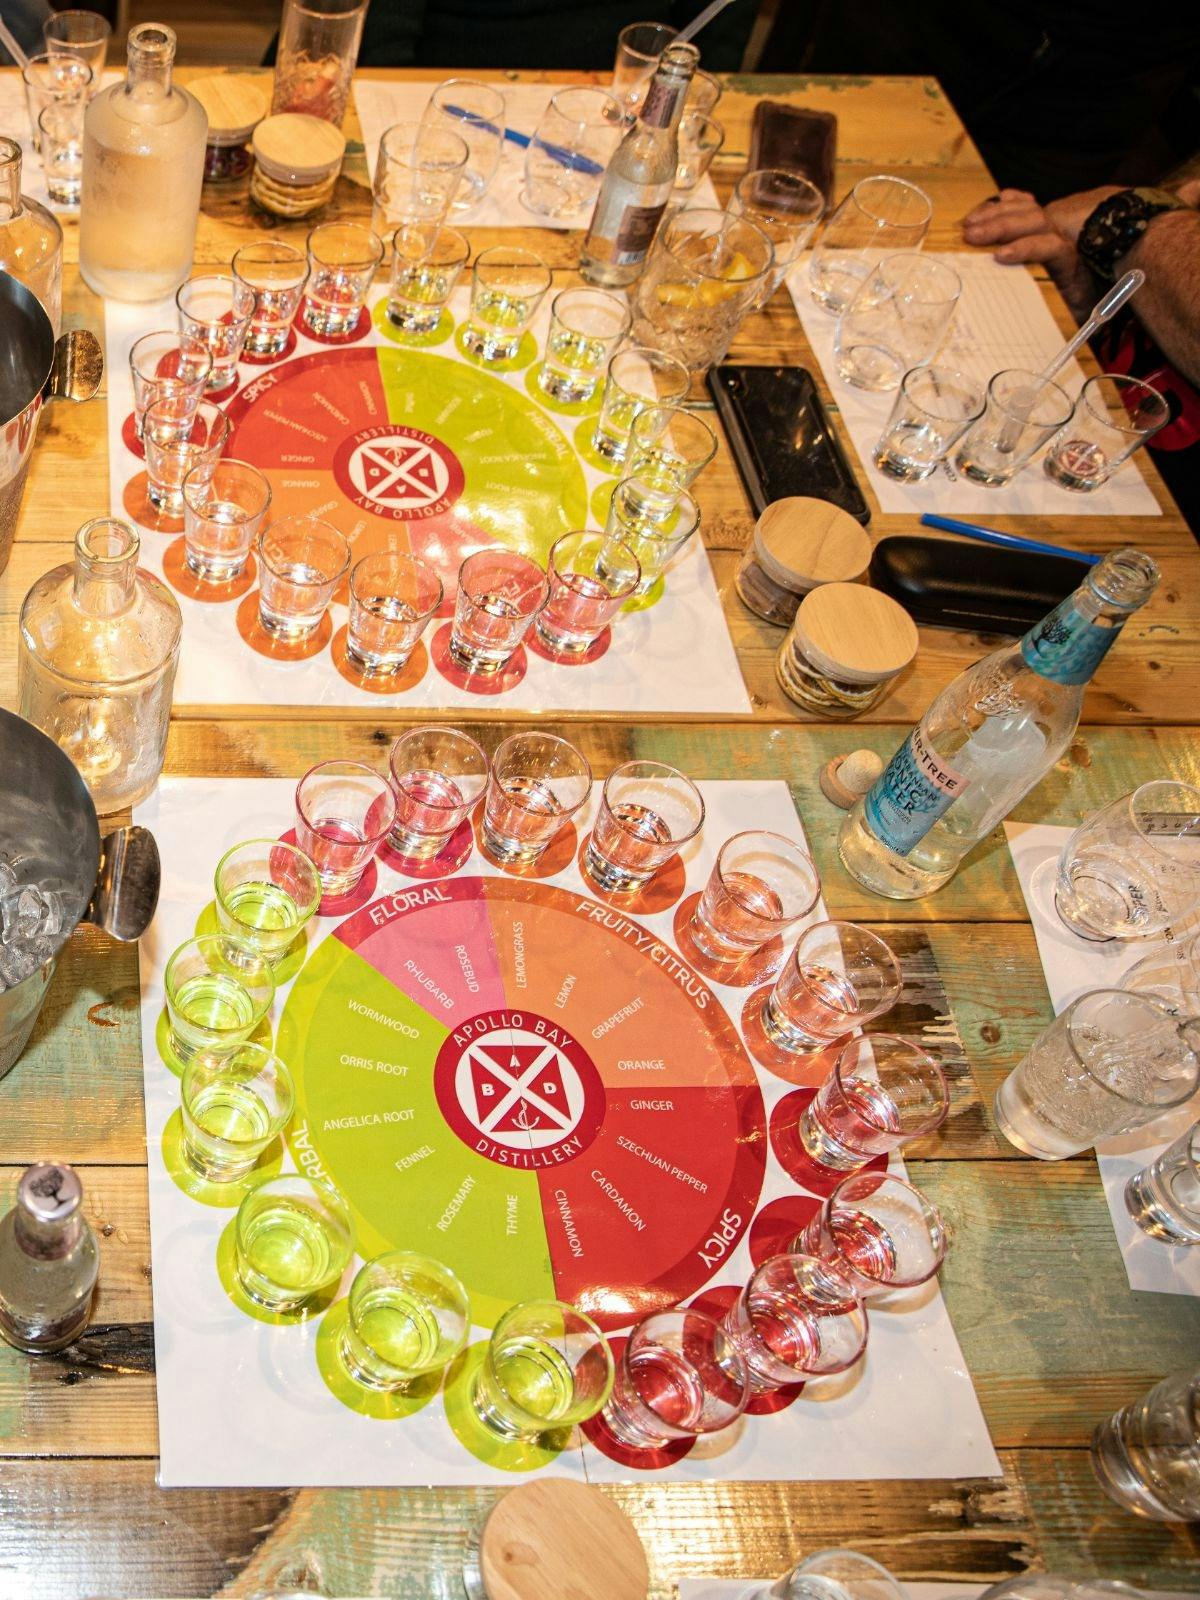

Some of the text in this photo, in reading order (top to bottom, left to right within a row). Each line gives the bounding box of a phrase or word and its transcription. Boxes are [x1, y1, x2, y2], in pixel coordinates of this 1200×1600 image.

[242, 373, 278, 404] SPICY
[353, 426, 435, 445] DISTILLERY
[354, 496, 452, 519] APOLLO BAY
[369, 886, 452, 926] FLORAL
[454, 944, 480, 993] ROSEBUD
[513, 921, 527, 989] LEMONGRASS
[575, 900, 710, 1009] FRUITY/CITRUS
[403, 959, 455, 1010] RHUBARB
[554, 974, 578, 1009] LEMON
[347, 1000, 420, 1040] WORMWOOD
[453, 1014, 573, 1049] APOLLO BAY
[591, 996, 645, 1040] GRAPEFRUIT
[340, 1054, 409, 1078] ORRIS ROOT
[617, 1059, 666, 1071] ORANGE
[480, 1083, 495, 1097] B
[542, 1082, 557, 1095] D
[630, 1099, 674, 1112] GINGER
[323, 1109, 416, 1131] ANGELICA ROOT
[292, 1119, 335, 1190] RBAL
[395, 1144, 436, 1172] FENNEL
[475, 1135, 583, 1168] DISTILLERY
[616, 1135, 708, 1194] SZECHUAN PEPPER
[436, 1175, 477, 1232] ROSEMARY
[506, 1193, 518, 1236] THYME
[590, 1170, 647, 1232] CARDAMON
[554, 1188, 584, 1259] CINNAMON
[697, 1207, 743, 1269] SPICY
